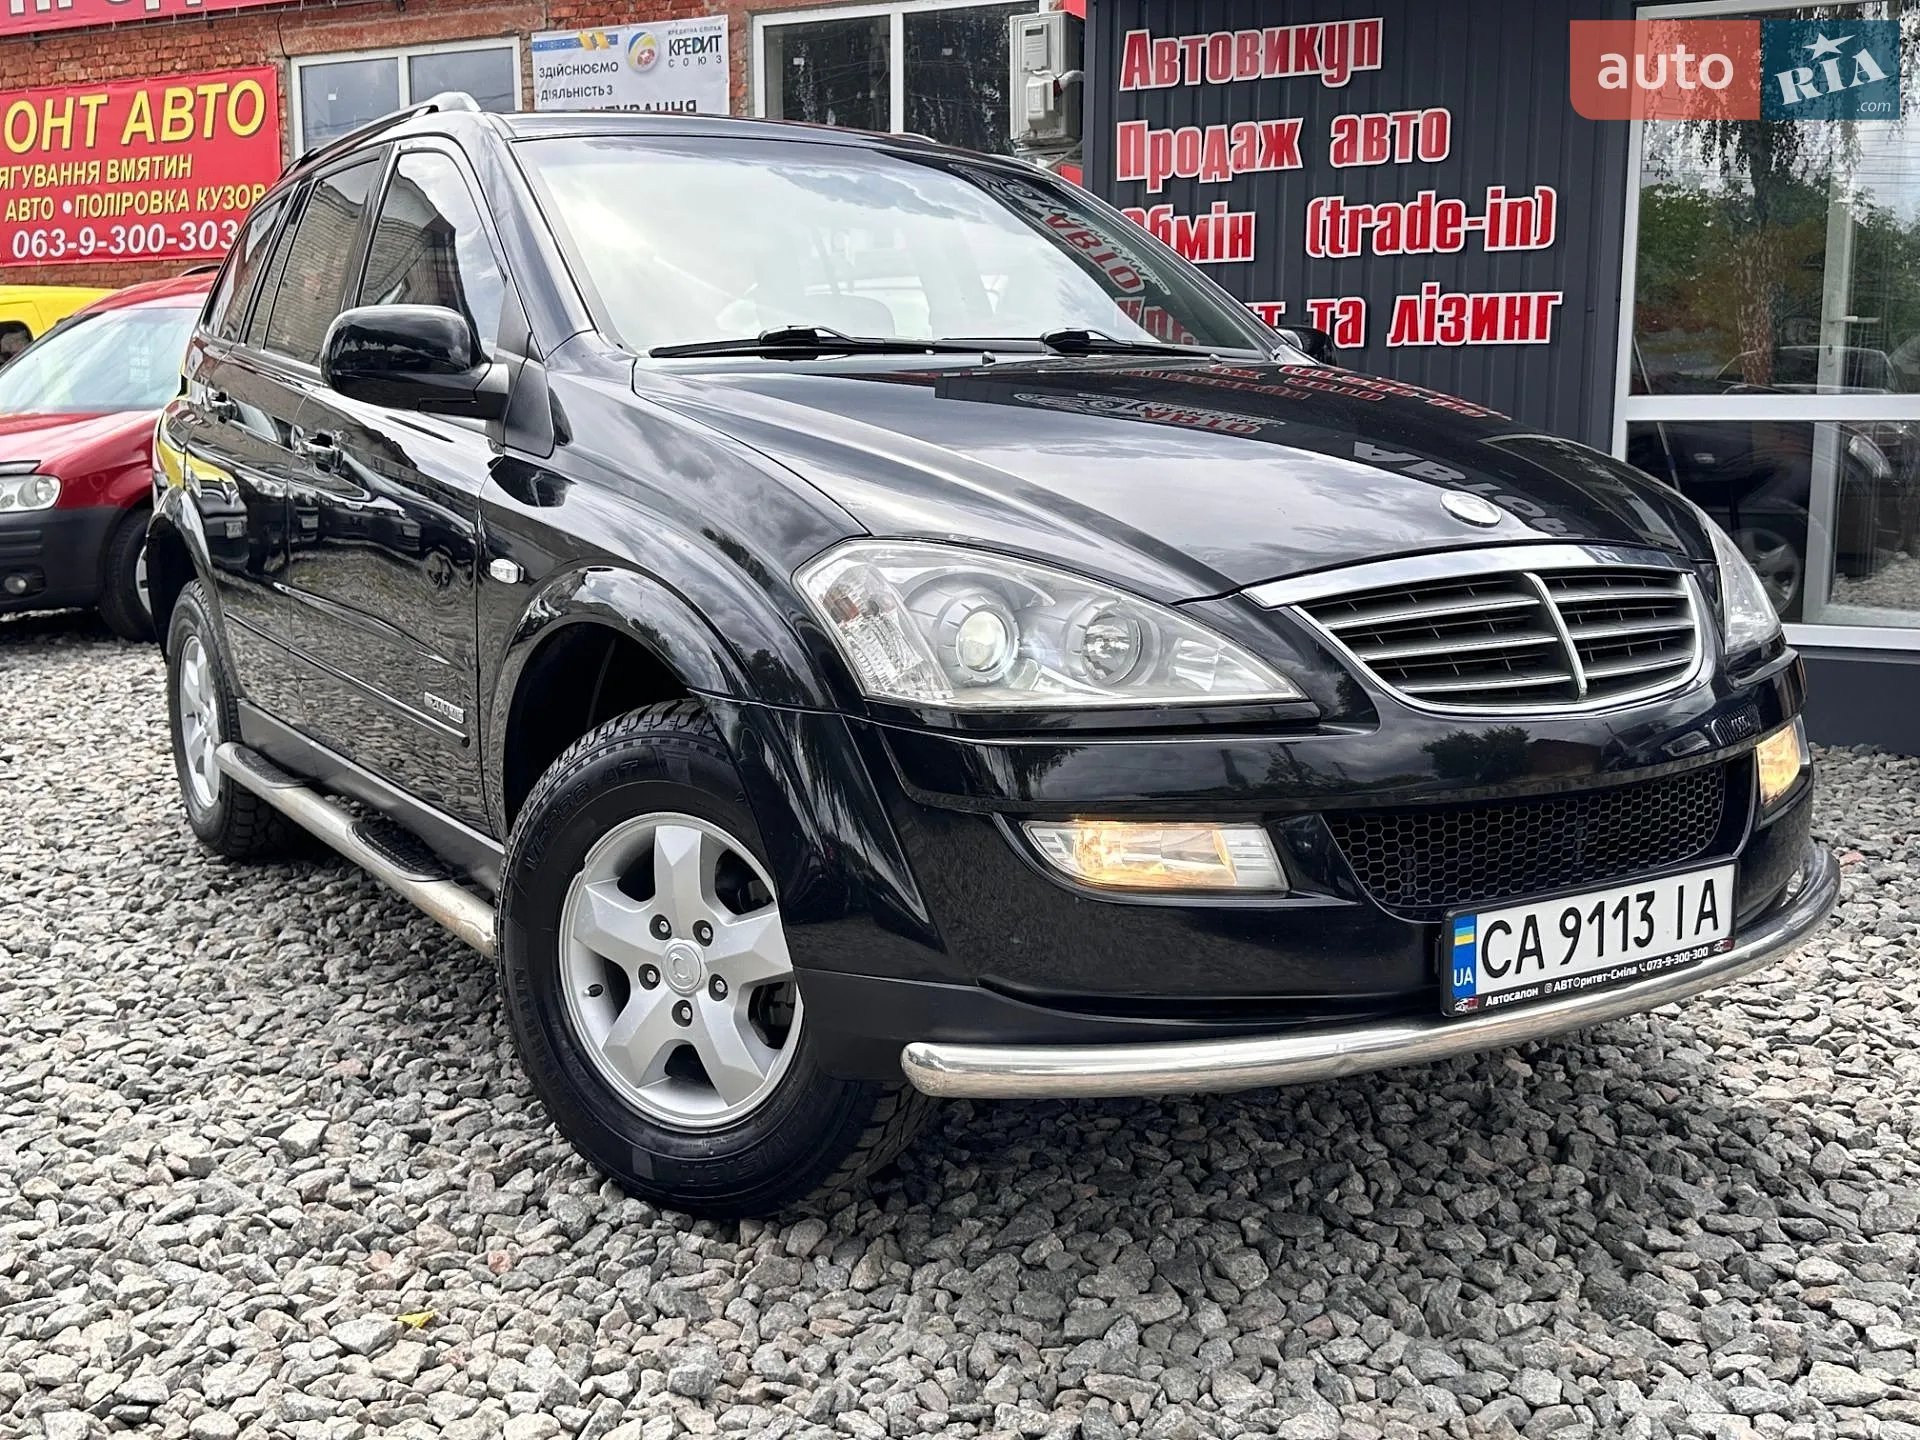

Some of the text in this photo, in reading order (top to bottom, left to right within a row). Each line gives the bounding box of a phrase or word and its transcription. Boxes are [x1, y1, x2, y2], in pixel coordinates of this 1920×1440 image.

[539, 61, 619, 79] ЗДІЙСНЮЄМО
[1119, 17, 1384, 91] Автовикуп
[4, 79, 266, 154] ОНТ АВТО
[540, 86, 605, 102] ДІЯЛЬНІСТЬ
[0, 153, 193, 190] ЯГУВАННЯ ВМЯТИН
[1116, 107, 1451, 193] Продаж авто
[4, 196, 55, 222] АВТО
[75, 187, 190, 218] ПОЛІРОВКА
[1119, 200, 1256, 264] бмін
[1306, 185, 1558, 259] (trade-in)
[12, 219, 239, 260] 063-9-300-303
[1307, 296, 1366, 348] та
[1387, 282, 1563, 348] лізинг
[1481, 878, 1719, 979] CA 9113 IA
[1453, 967, 1474, 988] UA
[1485, 987, 1539, 1007] Автосалон
[1646, 946, 1709, 971] 073-9-300-300
